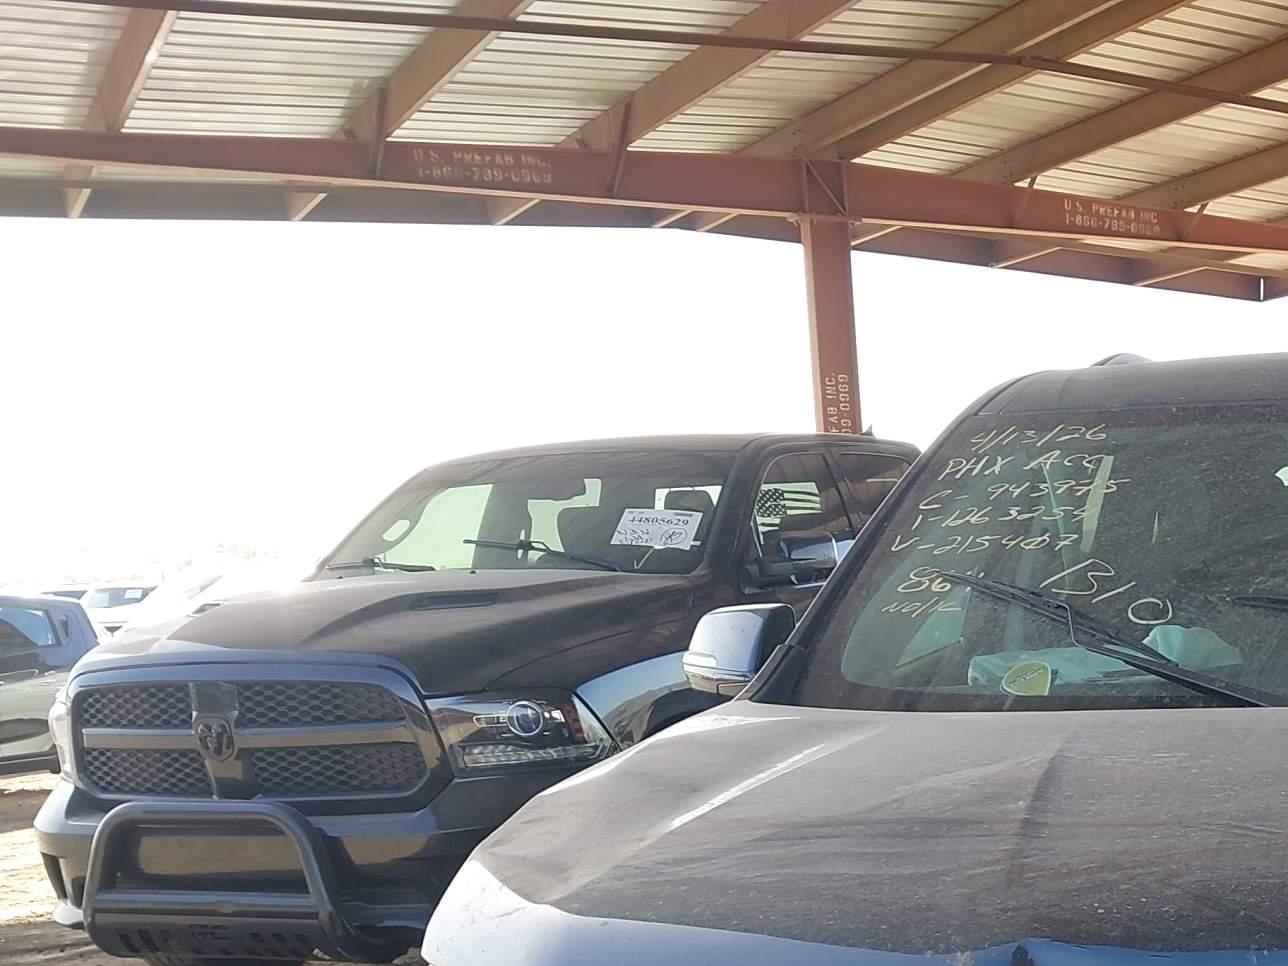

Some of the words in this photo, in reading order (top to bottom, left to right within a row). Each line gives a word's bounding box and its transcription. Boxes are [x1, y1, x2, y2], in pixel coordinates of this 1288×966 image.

[824, 372, 837, 399] INC.
[938, 456, 1015, 480] PHX
[628, 516, 690, 526] 44805629
